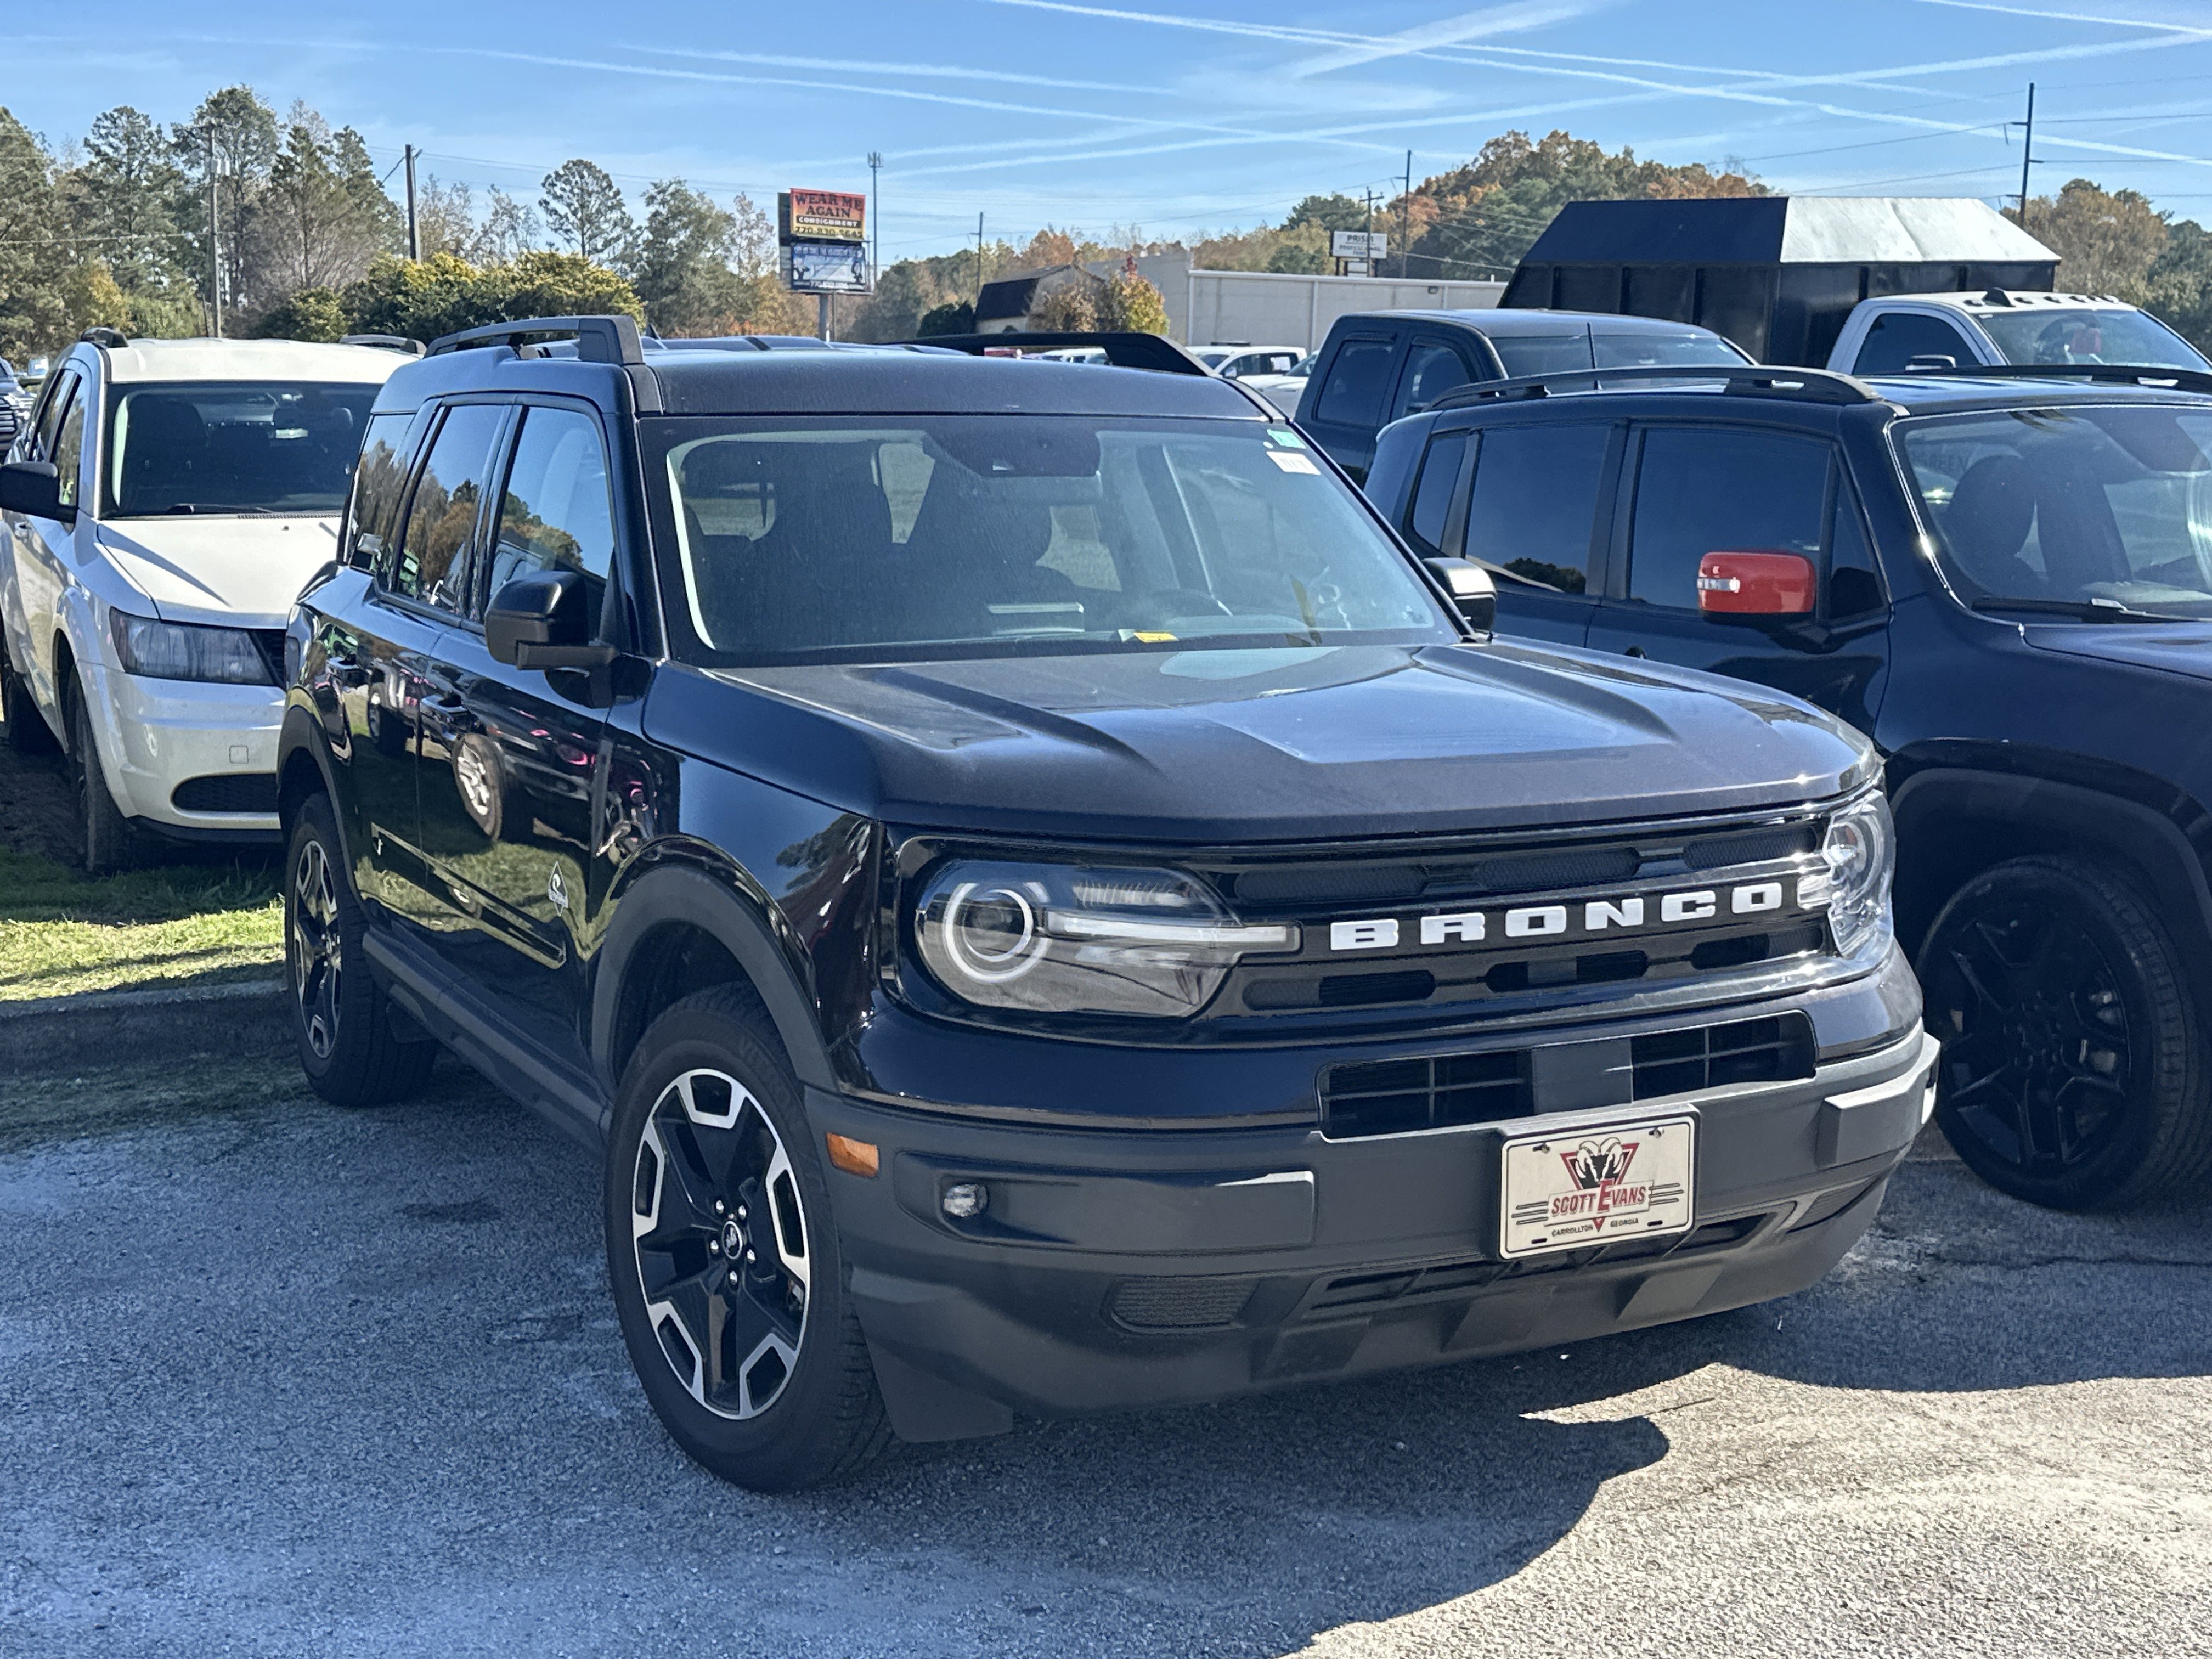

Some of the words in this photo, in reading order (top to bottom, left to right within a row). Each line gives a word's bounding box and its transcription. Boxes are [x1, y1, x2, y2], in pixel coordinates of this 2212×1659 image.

[795, 193, 838, 206] WEAR
[842, 195, 862, 212] ME
[805, 205, 851, 218] AGAIN
[798, 216, 858, 228] CONSIGNMENT
[1329, 882, 1783, 951] BRONCO
[1551, 1193, 1597, 1217] SCOTT
[1596, 1177, 1646, 1213] EVANS
[1551, 1224, 1594, 1237] CARROLLTON
[1610, 1217, 1639, 1228] GEORGIA
